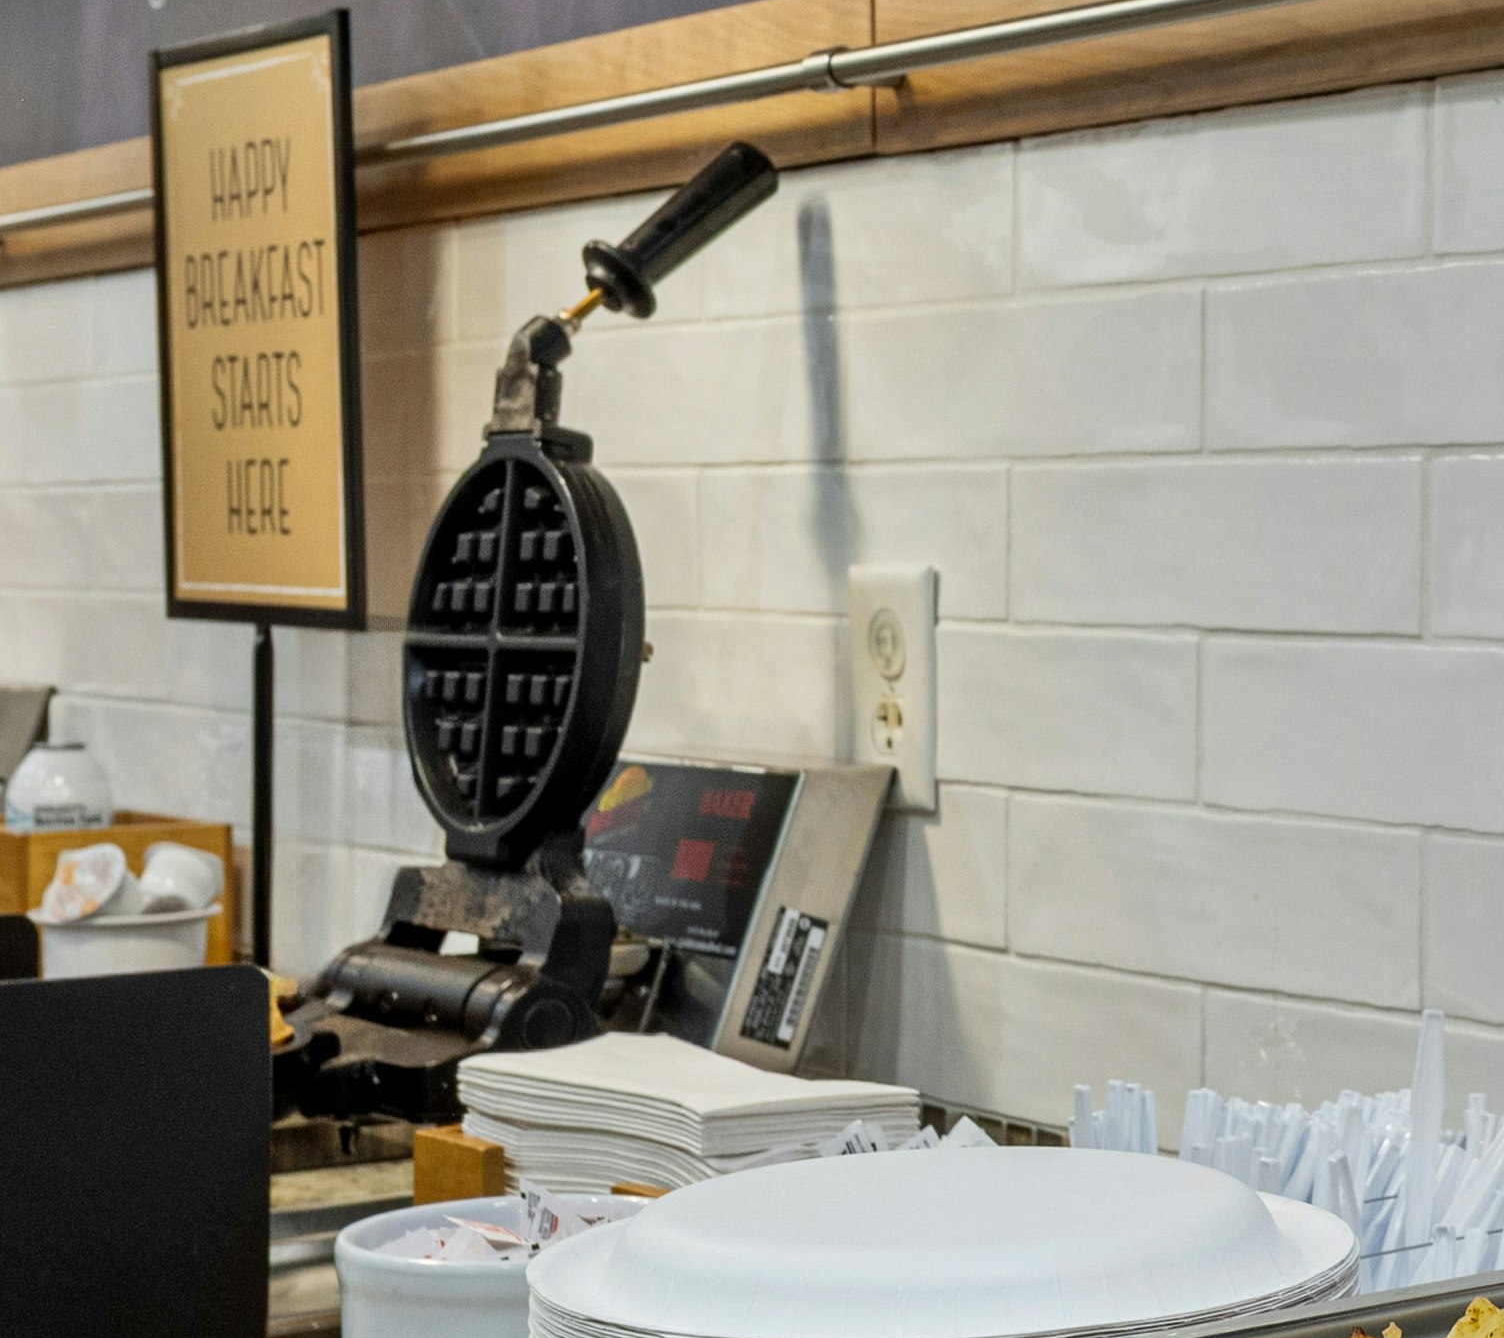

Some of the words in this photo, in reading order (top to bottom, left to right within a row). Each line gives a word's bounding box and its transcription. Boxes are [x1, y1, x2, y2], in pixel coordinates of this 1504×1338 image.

[208, 137, 293, 222] HAPPY
[184, 239, 326, 329] BREAKFAST
[210, 350, 304, 432] STARTS
[226, 459, 292, 537] HERE
